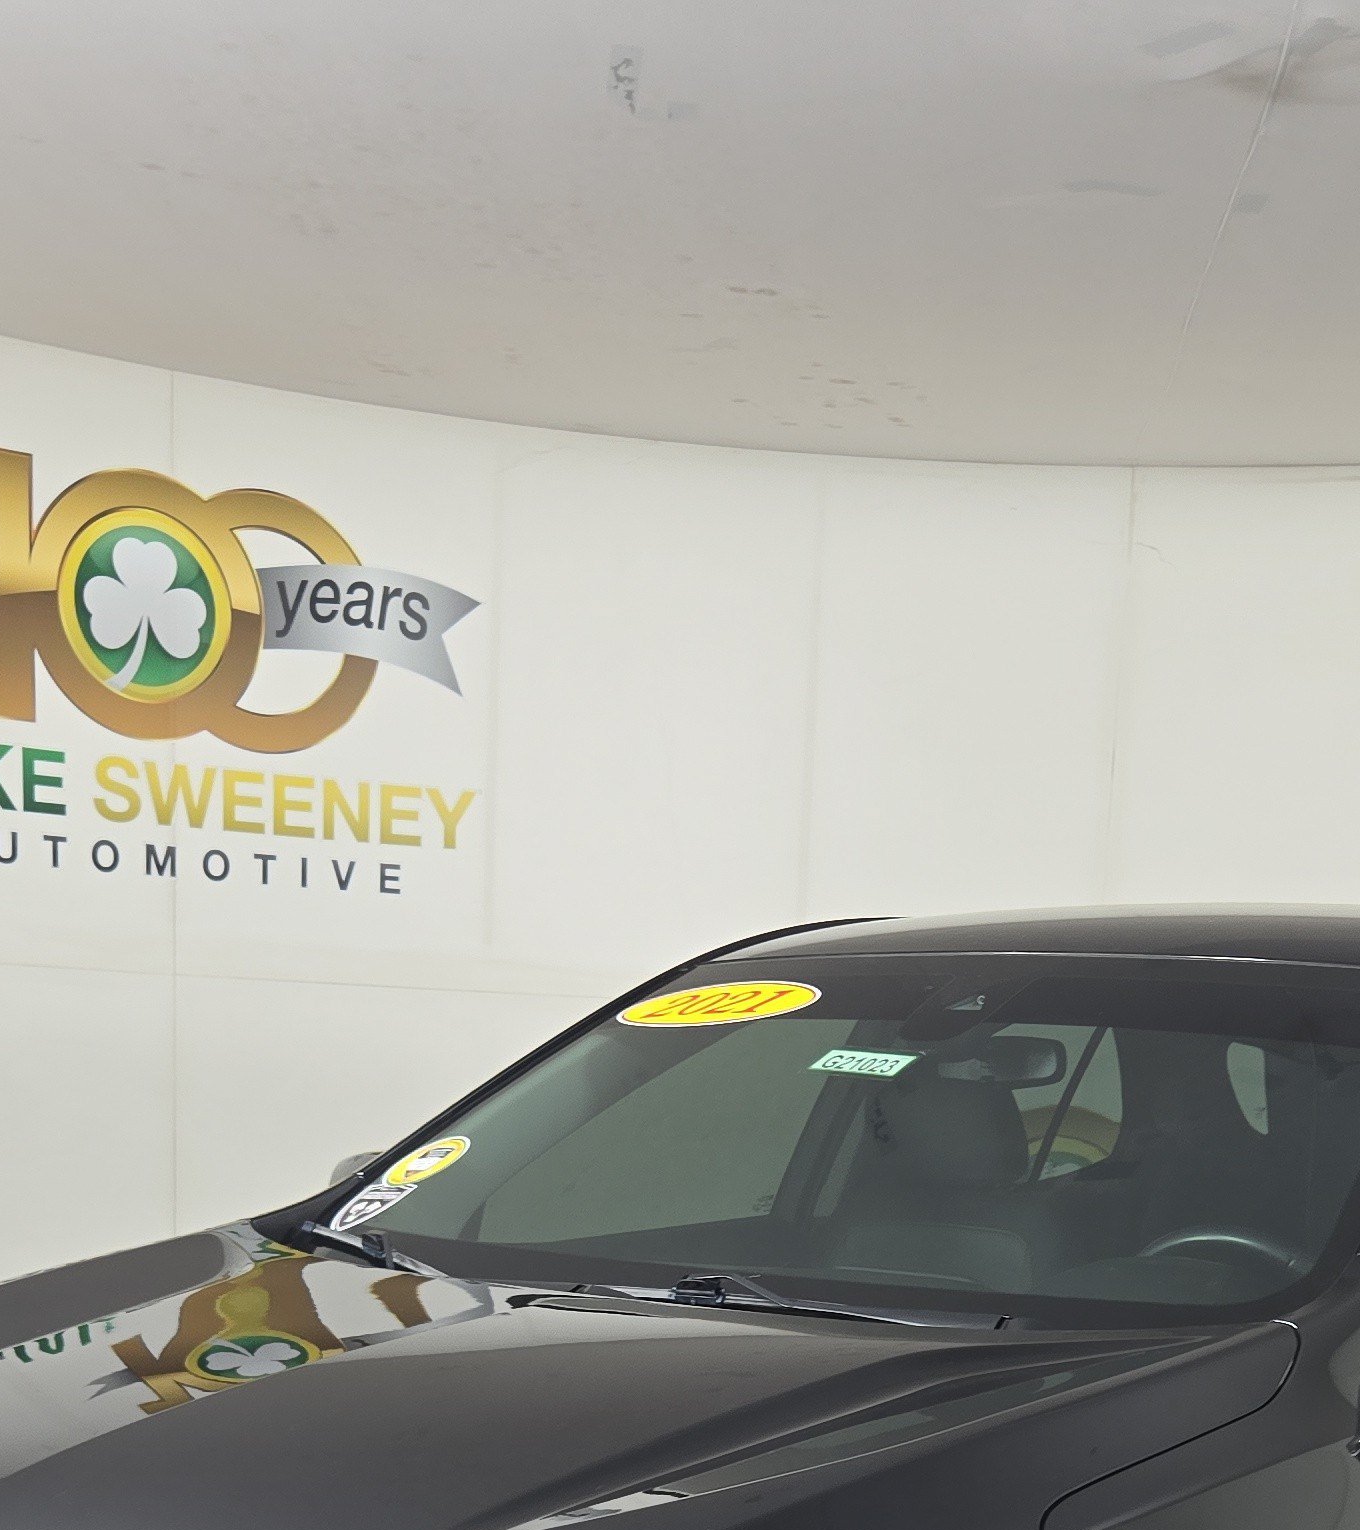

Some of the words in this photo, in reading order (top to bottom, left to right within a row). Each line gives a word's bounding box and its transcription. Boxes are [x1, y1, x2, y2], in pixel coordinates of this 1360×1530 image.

[275, 576, 431, 641] years
[93, 753, 476, 850] SWEENEY
[639, 989, 795, 1019] 2021
[821, 1054, 900, 1073] G21023
